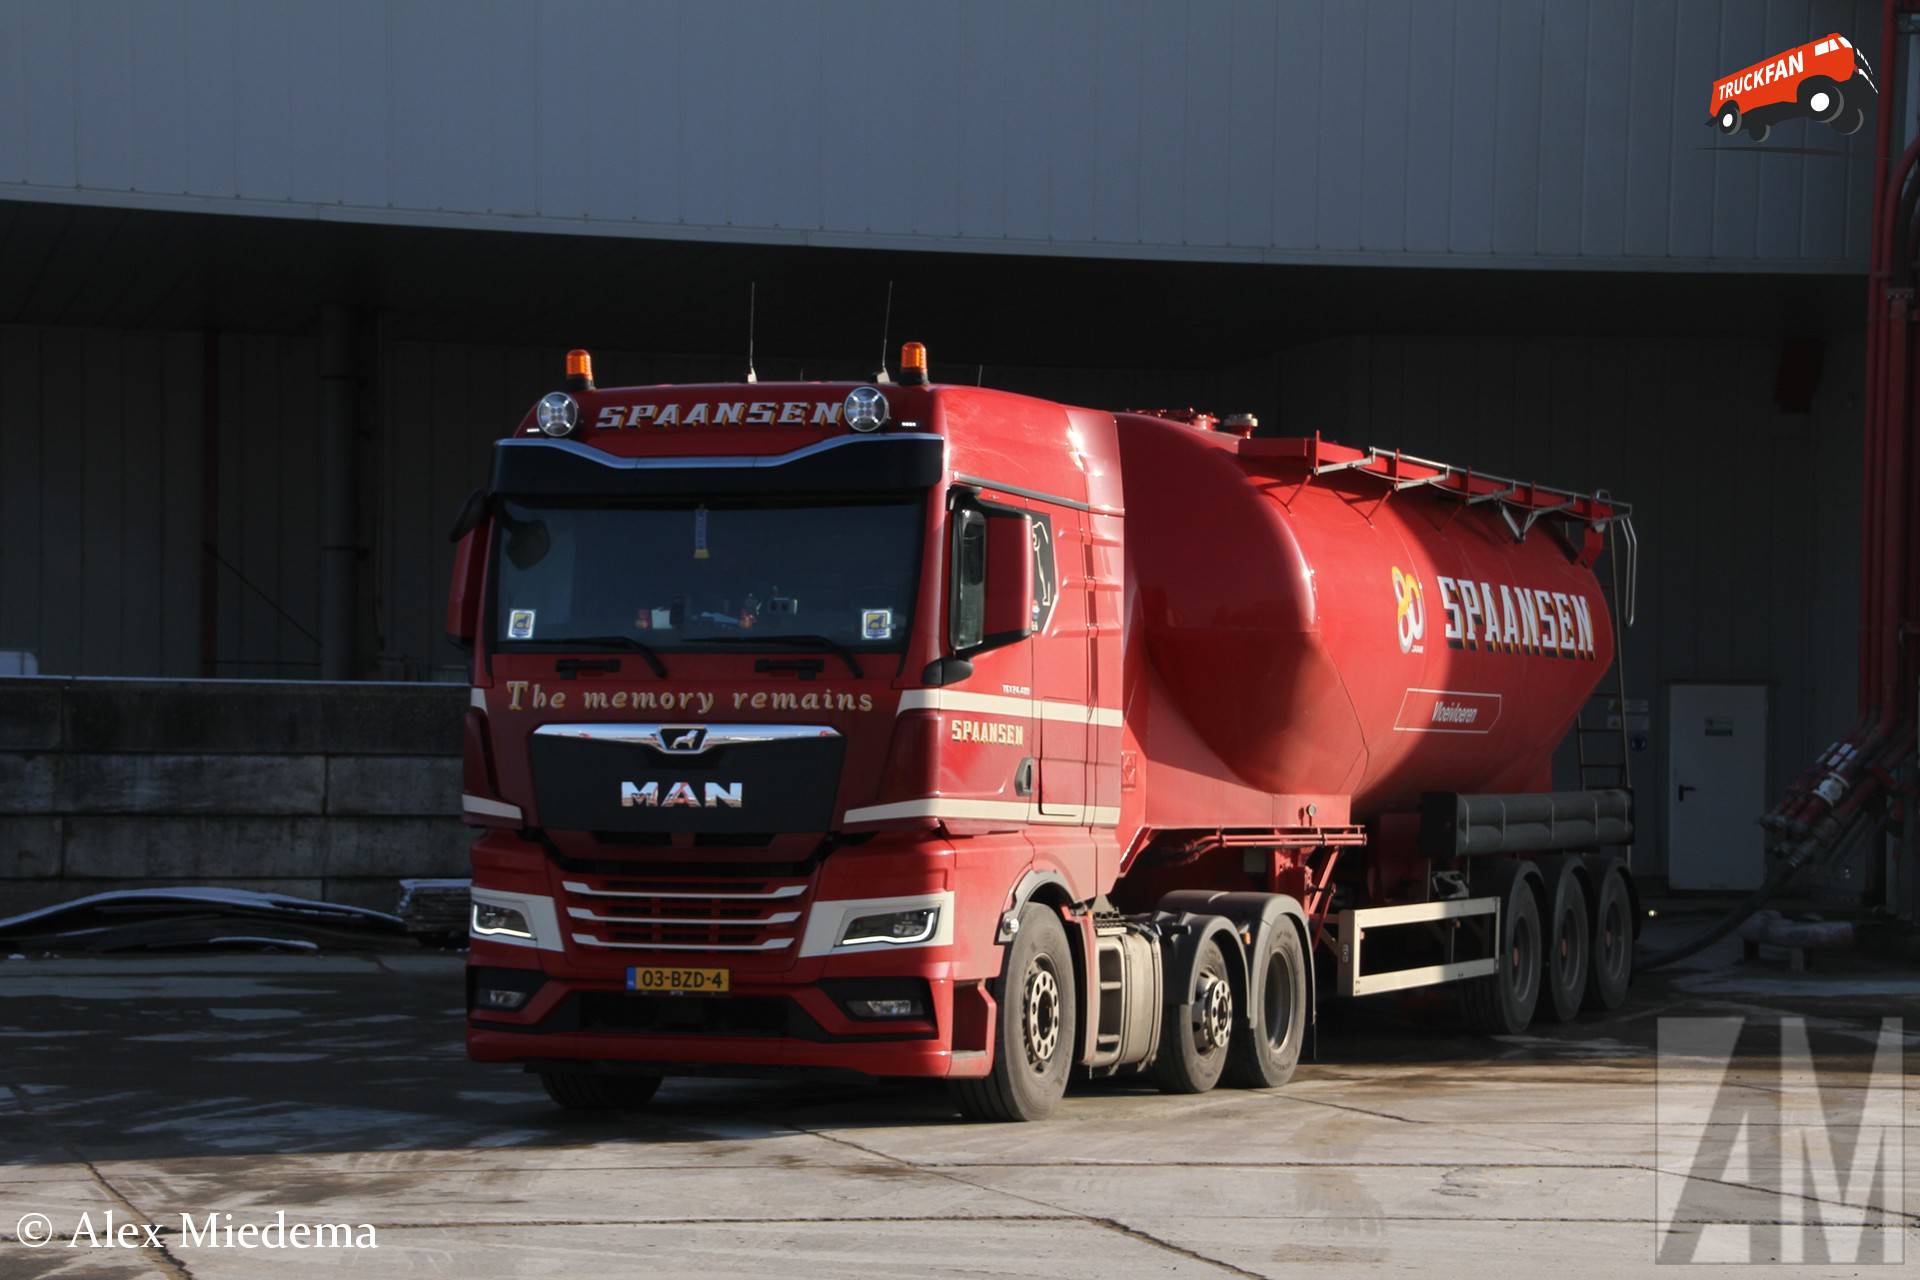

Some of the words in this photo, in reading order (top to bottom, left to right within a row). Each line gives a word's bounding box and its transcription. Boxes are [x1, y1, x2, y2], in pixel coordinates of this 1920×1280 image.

[595, 402, 843, 430] SPAANSEN
[1392, 566, 1424, 654] 80
[1437, 576, 1595, 661] SPAANSEN
[506, 680, 567, 711] The
[583, 688, 714, 714] memory
[732, 688, 874, 712] remains
[951, 719, 1024, 746] SPAANSEN
[621, 781, 743, 808] MAN
[642, 970, 723, 989] 03-BZD-4
